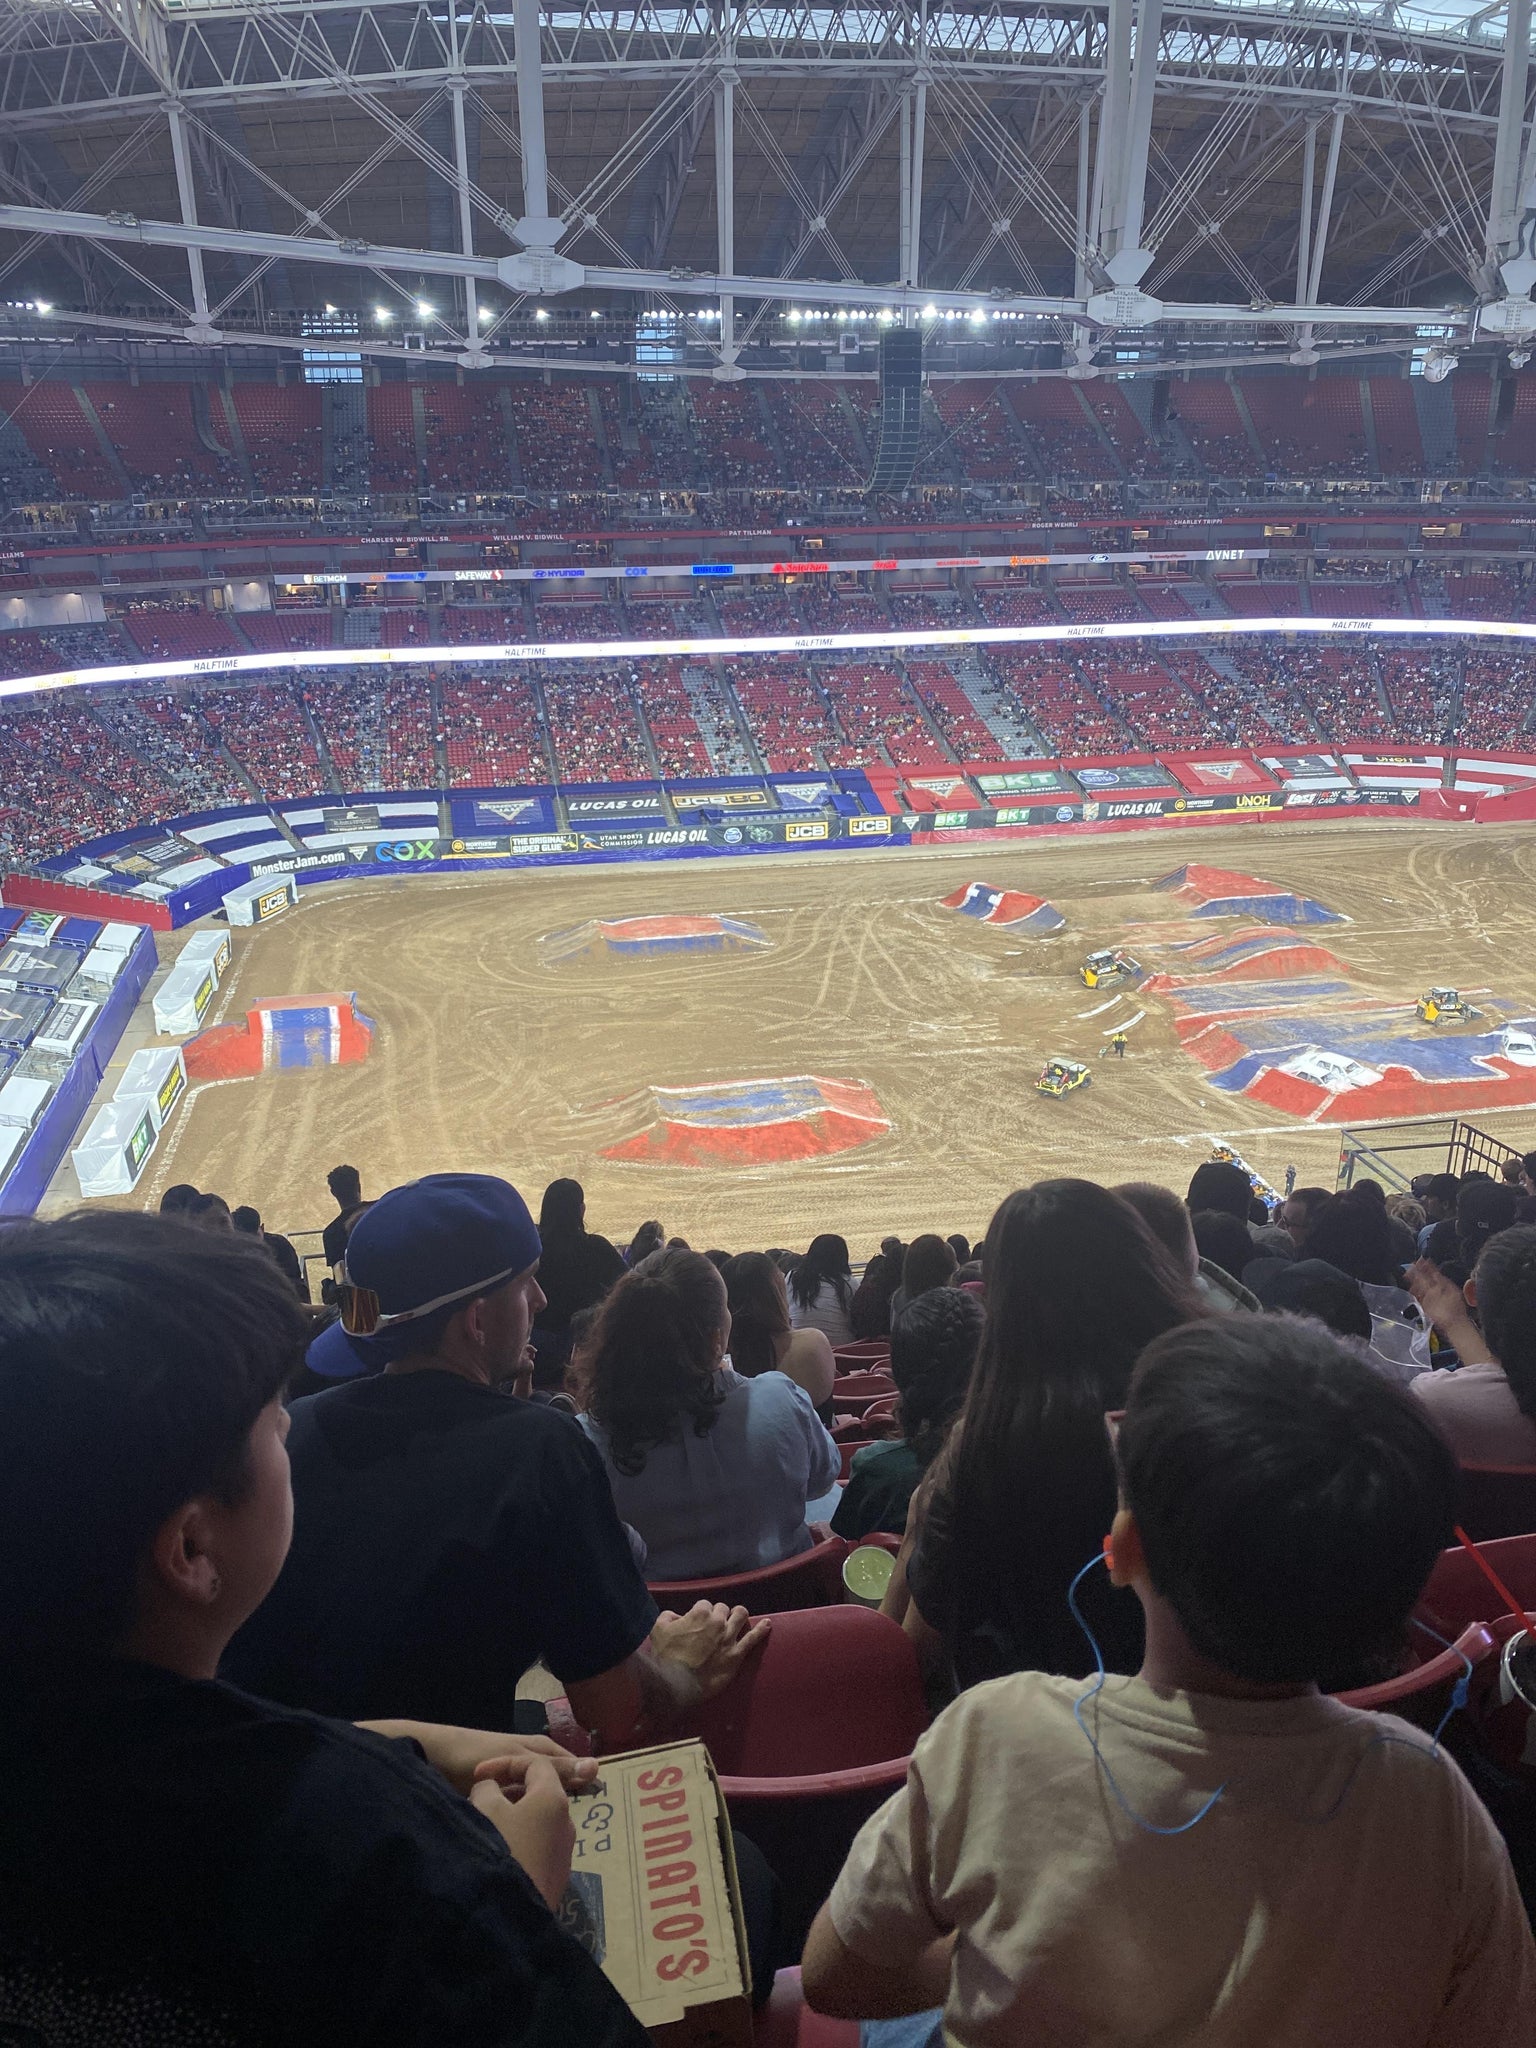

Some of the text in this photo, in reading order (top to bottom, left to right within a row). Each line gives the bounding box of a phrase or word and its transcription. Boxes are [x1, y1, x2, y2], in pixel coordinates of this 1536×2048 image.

[1206, 550, 1245, 560] AVNET
[455, 570, 492, 580] SAFEWAY
[625, 567, 648, 576] COX
[1068, 627, 1105, 635] HALFTIME
[1332, 621, 1373, 630] HALFTIME
[795, 638, 834, 647] HALFTIME
[504, 648, 546, 656] HALFTIME
[194, 659, 238, 670] HALFTIME
[980, 774, 1052, 788] BKT
[568, 799, 660, 810] LUCAS OIL
[1236, 795, 1271, 806] UNOH
[1108, 802, 1162, 816] LUCAS OIL
[936, 812, 968, 826] BKT
[997, 810, 1029, 823] BKT
[852, 820, 888, 832] JCB
[647, 829, 708, 844] LUCAS OIL
[790, 826, 825, 838] JCB
[529, 835, 566, 845] ORIGINAL
[375, 840, 435, 861] COX
[512, 844, 540, 853] SUPER
[252, 852, 345, 878] MonsterJam.com
[262, 892, 285, 912] JCB
[636, 1766, 710, 1982] SPINATO'S
